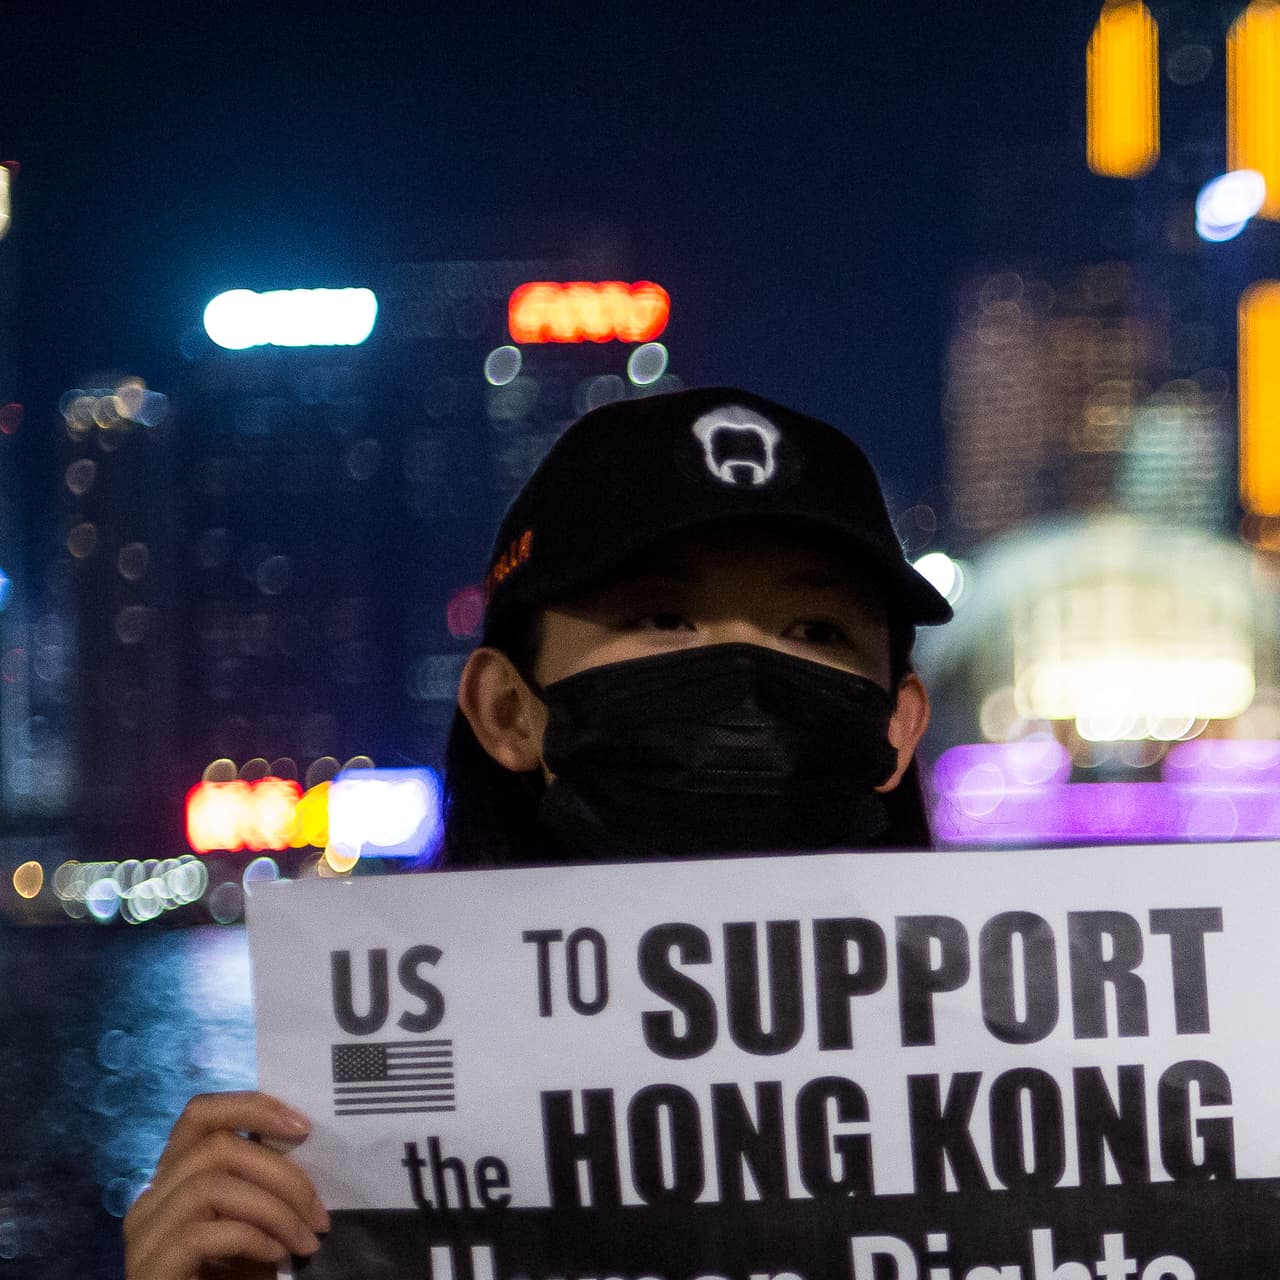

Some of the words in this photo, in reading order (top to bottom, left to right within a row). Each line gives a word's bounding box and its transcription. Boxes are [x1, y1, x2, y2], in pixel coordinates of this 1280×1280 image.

[330, 945, 446, 1036] US
[522, 926, 610, 1018] TO
[636, 906, 1224, 1060] SUPPORT
[402, 1136, 512, 1210] the
[540, 1074, 876, 1208] HONG
[906, 1060, 1236, 1192] KONG
